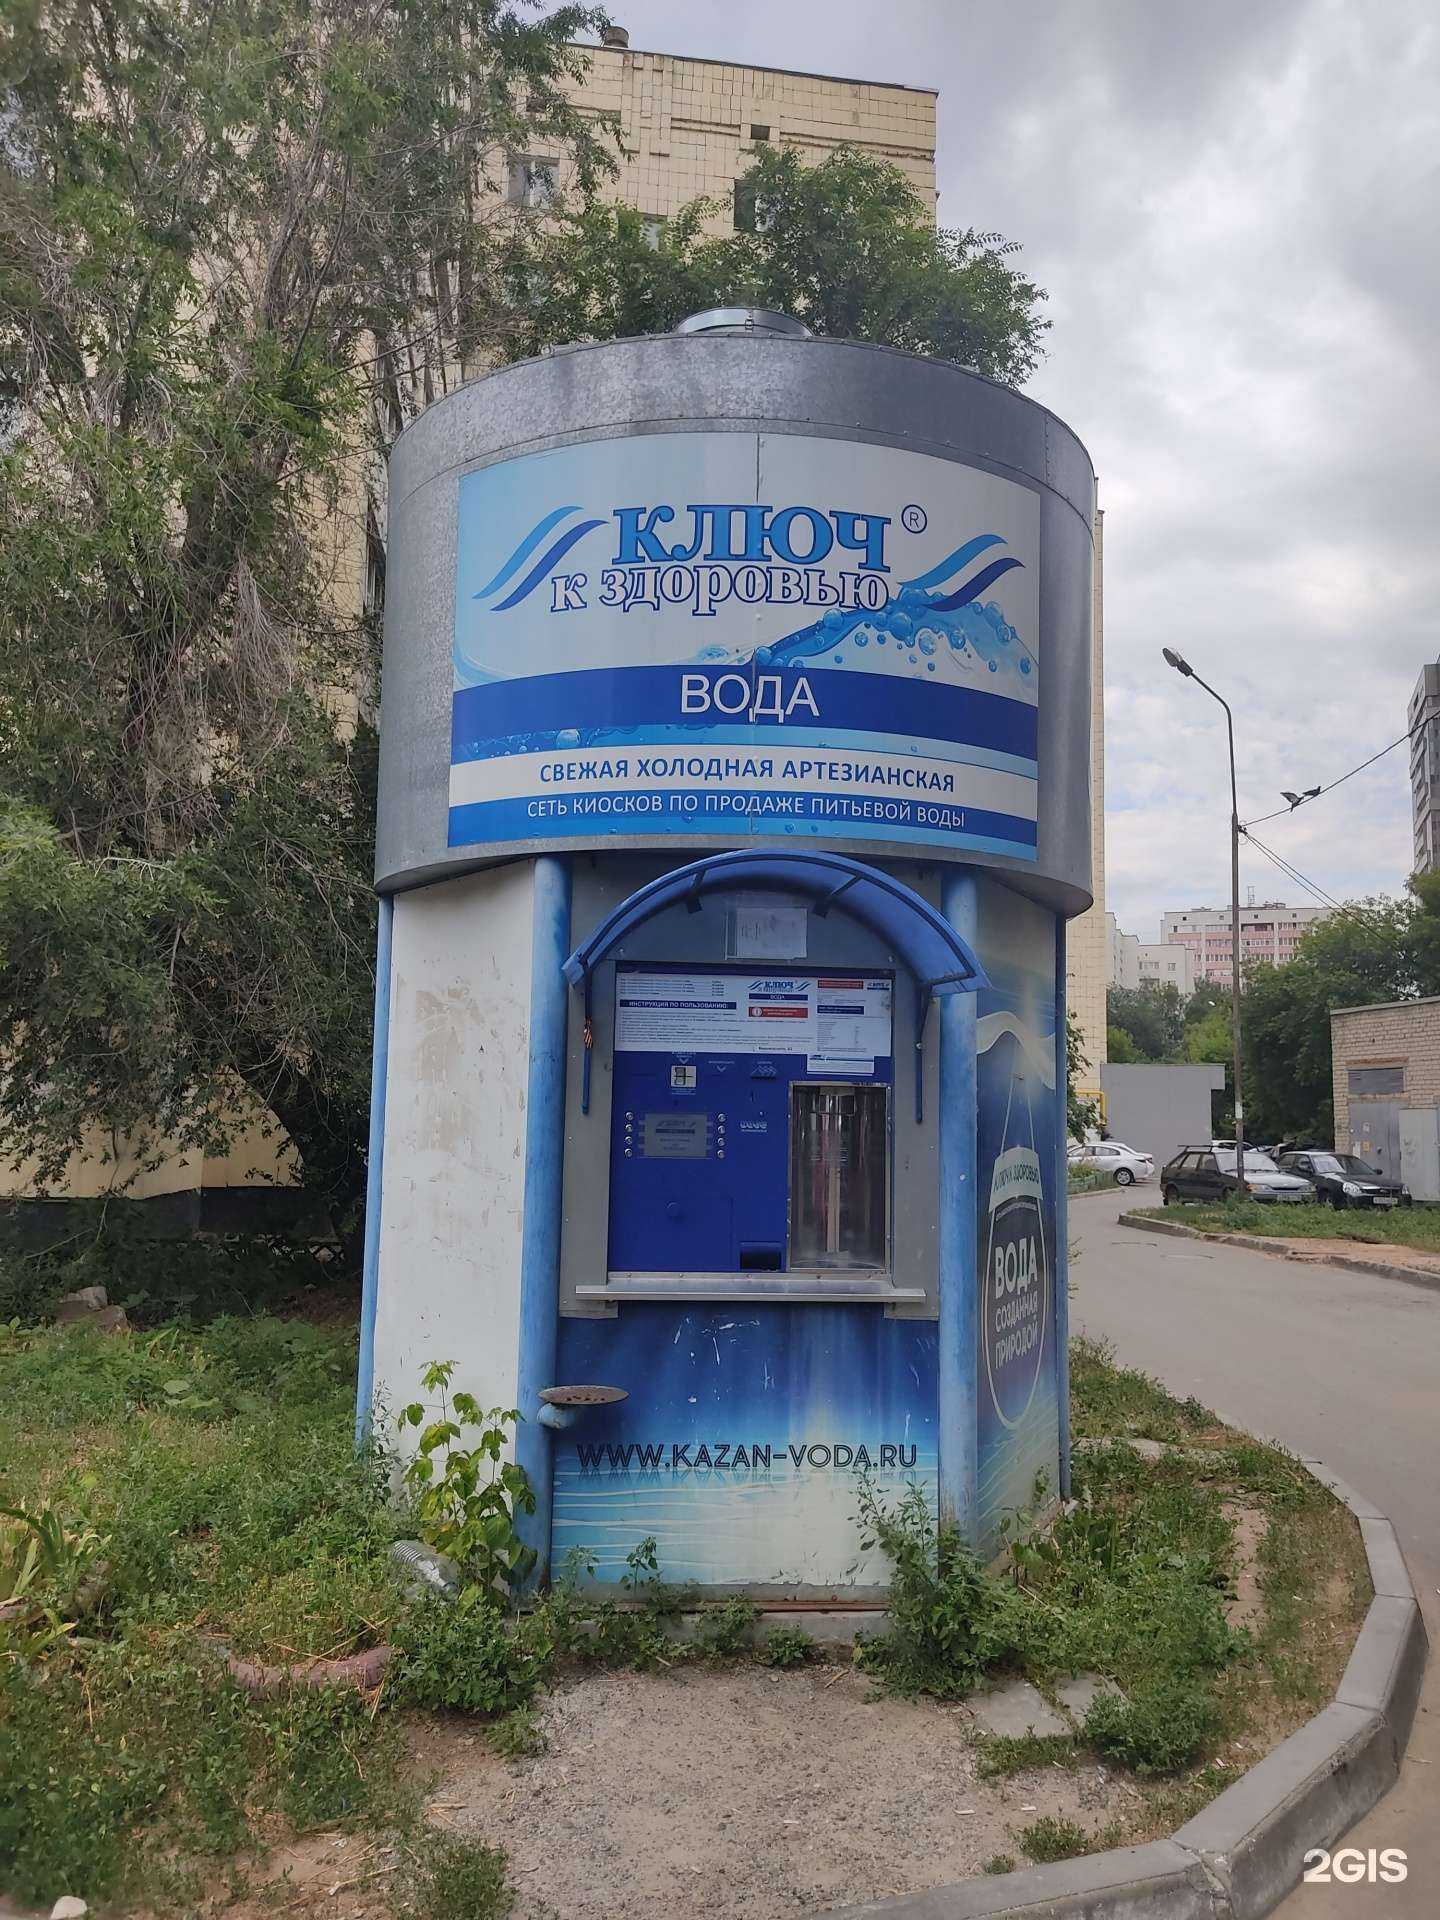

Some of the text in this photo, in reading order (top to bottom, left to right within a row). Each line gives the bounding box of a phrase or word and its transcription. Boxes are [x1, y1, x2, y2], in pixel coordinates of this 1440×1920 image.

[611, 504, 892, 573] КЛЮЧ
[680, 674, 820, 724] ВОДА
[540, 758, 955, 793] СВЕЖАЯ ХОЛОДНАЯ АРТЕЗИАНСКАЯ
[527, 795, 965, 829] СЕТЬ КИОСКОВ ПО ПРОДАЖЕ ПИТЬЕВОЙ ВОДЫ
[995, 1236, 1038, 1299] ВОДА
[995, 1293, 1038, 1333] СОЗДАННАЯ
[995, 1318, 1038, 1369] ПРИРОДОЙ
[576, 1443, 918, 1468] WWW.KAZAN-VODA.RU
